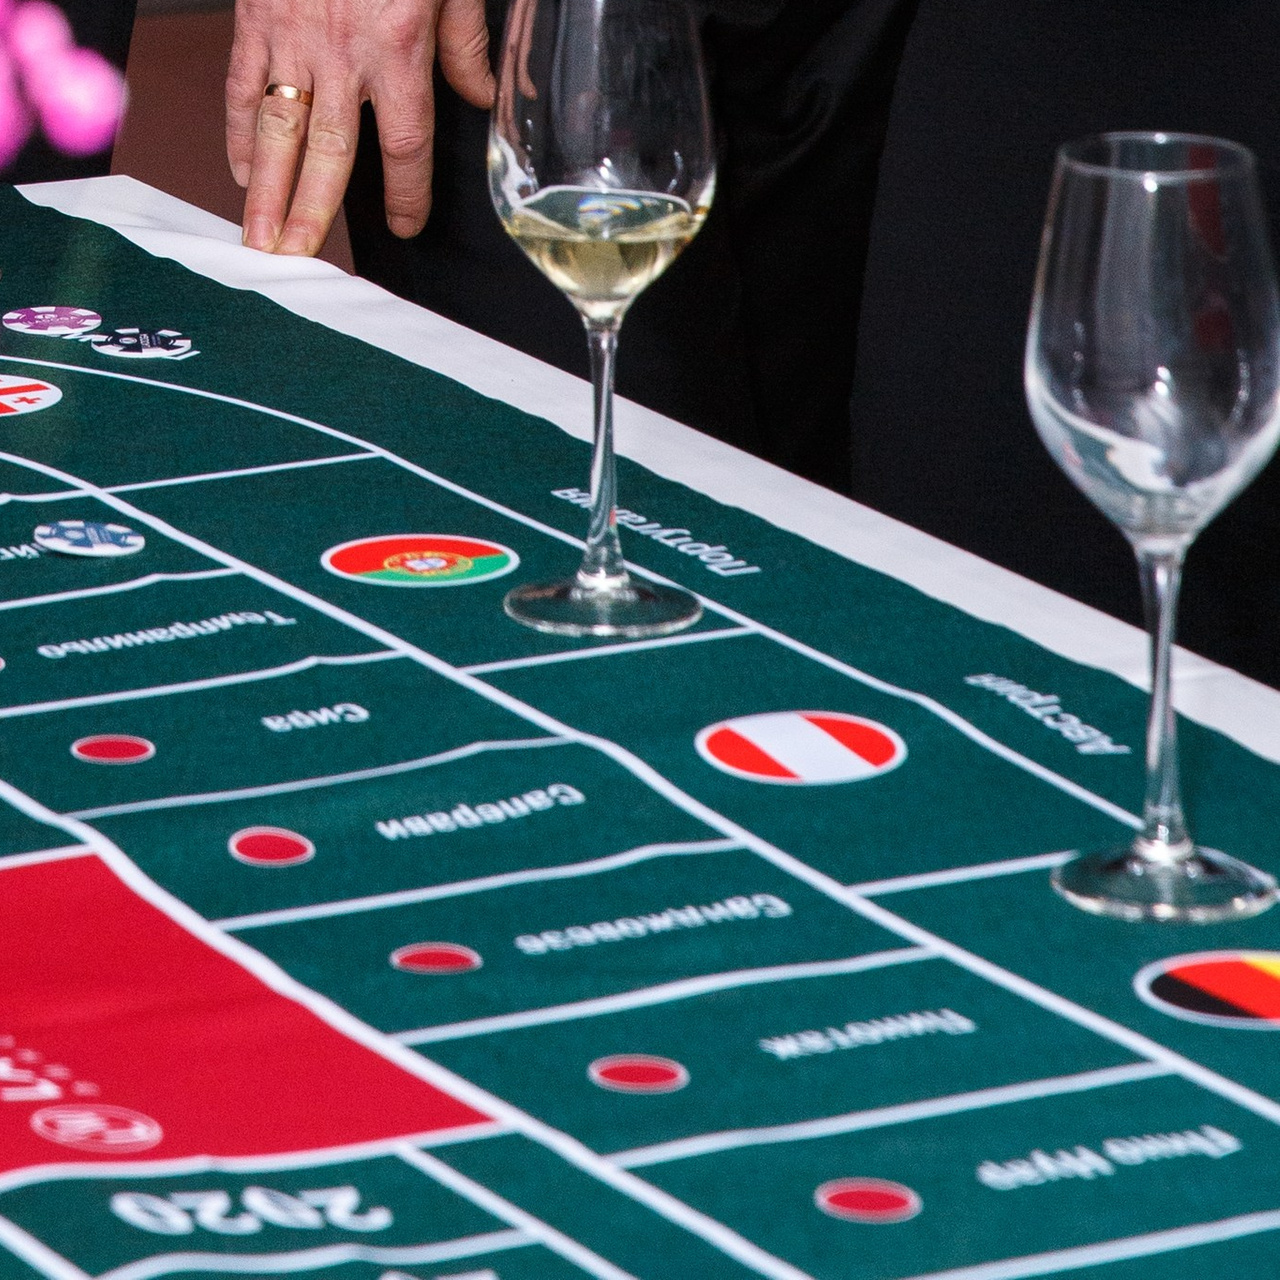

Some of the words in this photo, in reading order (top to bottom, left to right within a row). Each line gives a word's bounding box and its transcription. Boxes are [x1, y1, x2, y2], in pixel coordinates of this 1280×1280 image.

[36, 609, 297, 659] Темпранильо
[261, 702, 370, 733] Сира
[964, 672, 1132, 754] Австрия
[375, 782, 586, 840] Саперави
[515, 893, 793, 955] Санджовезе
[760, 1006, 977, 1060] Пинотаж
[976, 1145, 1114, 1191] Нуар
[1104, 1124, 1241, 1167] Пино
[111, 1184, 393, 1236] 2020
